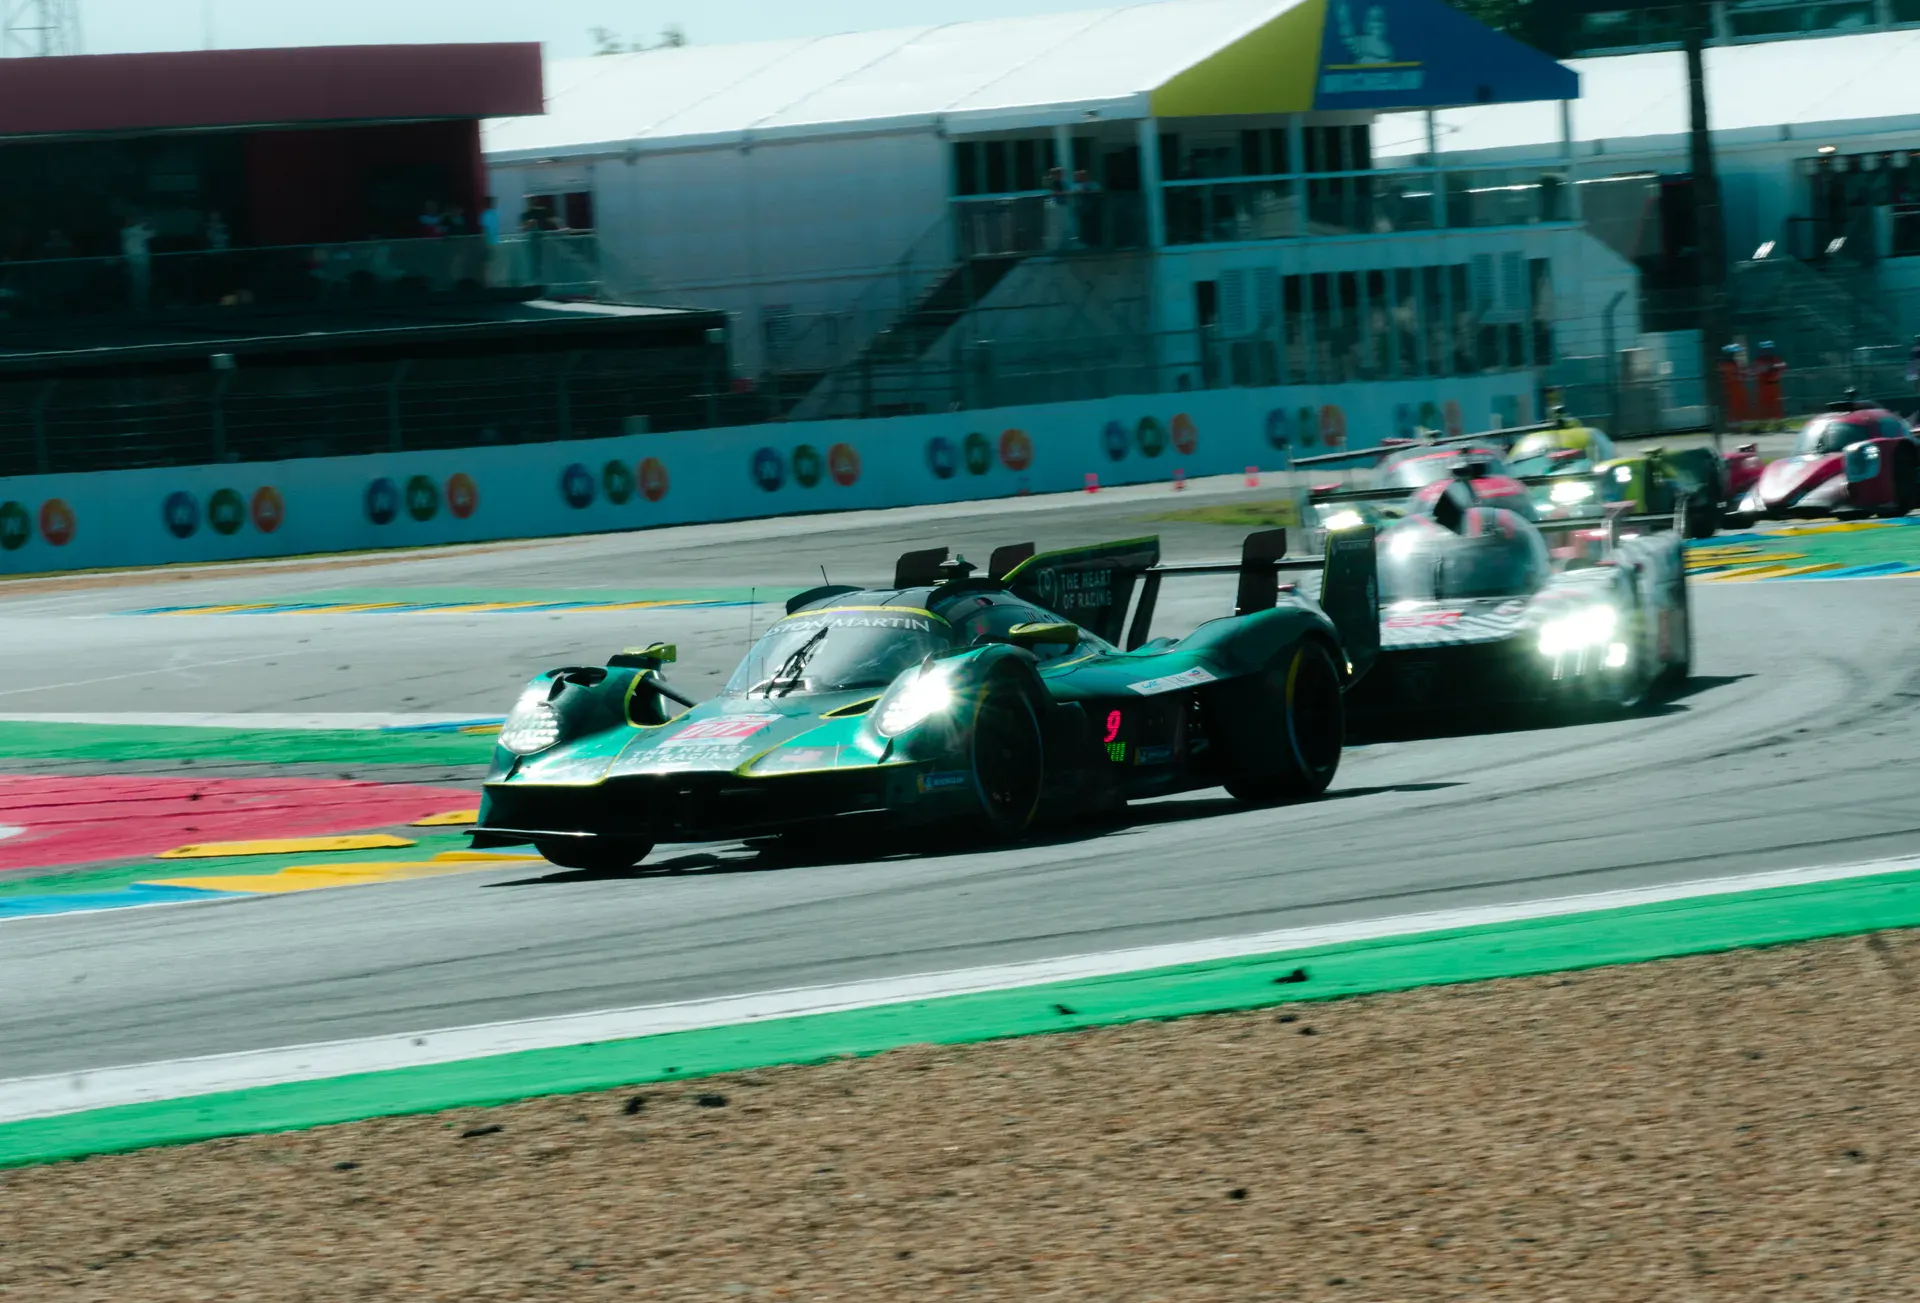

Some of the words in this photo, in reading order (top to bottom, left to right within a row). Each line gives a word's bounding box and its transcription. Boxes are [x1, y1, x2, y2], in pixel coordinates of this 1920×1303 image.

[1060, 572, 1080, 590] THE
[1081, 569, 1112, 588] HEART
[1063, 593, 1075, 610] OF
[1077, 590, 1112, 608] RACING
[829, 617, 930, 632] MARTIN
[1103, 709, 1122, 743] 9
[678, 745, 752, 755] HEART
